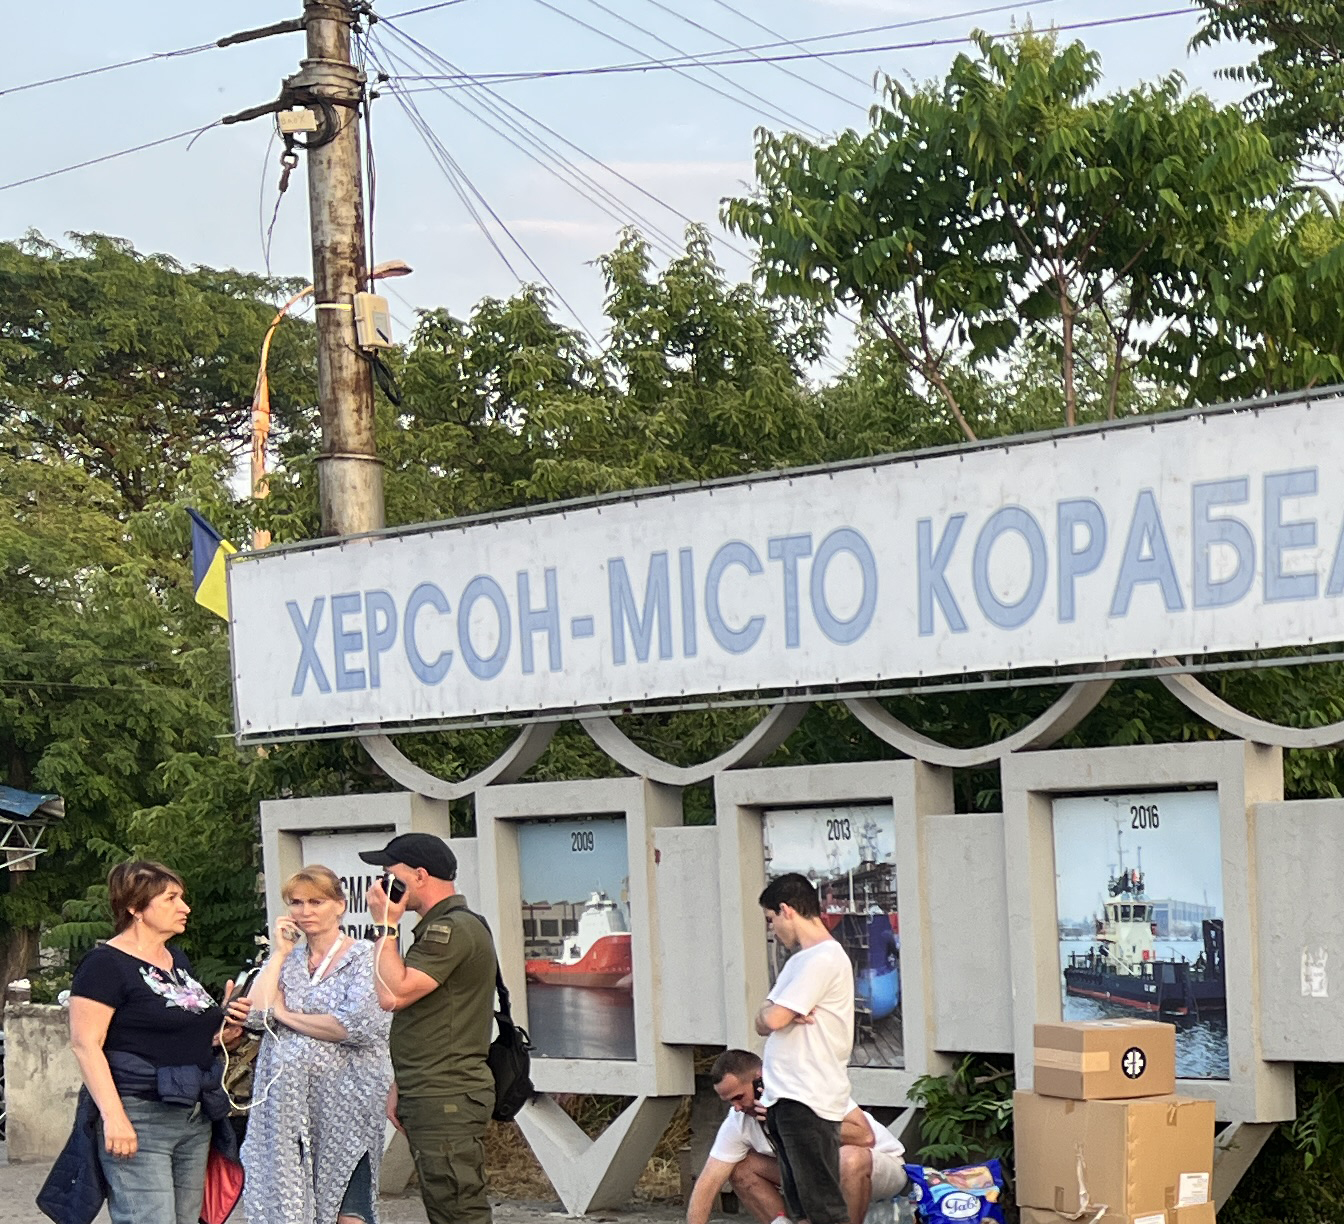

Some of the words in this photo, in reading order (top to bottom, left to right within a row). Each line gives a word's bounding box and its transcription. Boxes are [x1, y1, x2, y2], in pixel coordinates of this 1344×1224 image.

[1130, 804, 1160, 829] 2016
[571, 831, 594, 851] 2009
[826, 818, 851, 841] 2013
